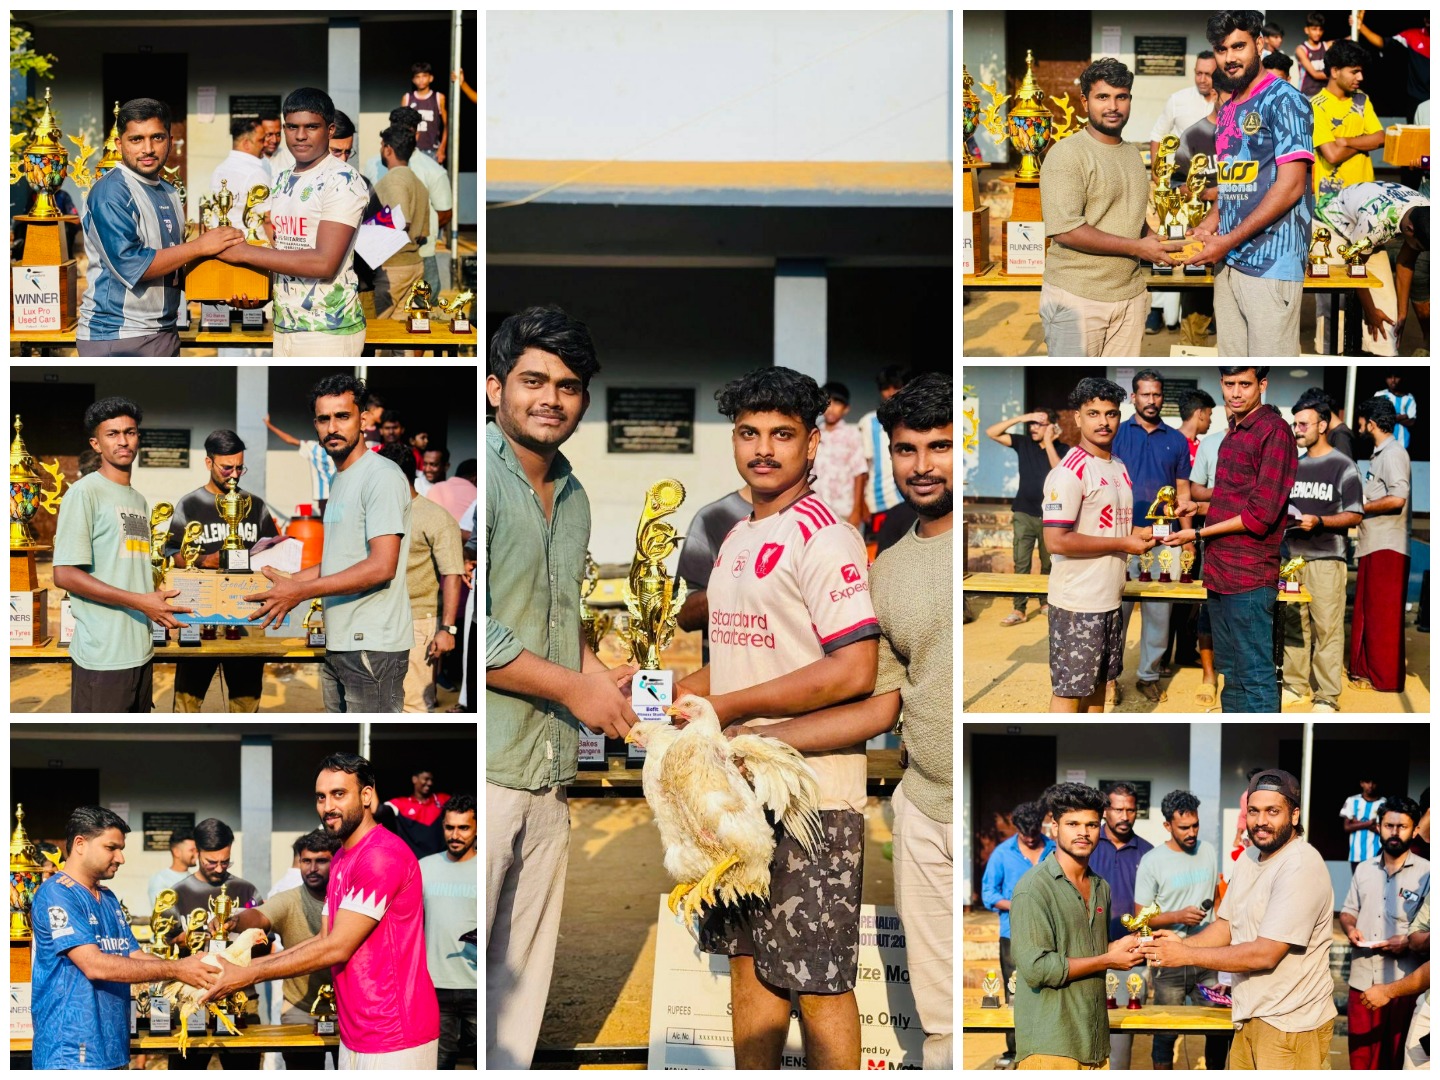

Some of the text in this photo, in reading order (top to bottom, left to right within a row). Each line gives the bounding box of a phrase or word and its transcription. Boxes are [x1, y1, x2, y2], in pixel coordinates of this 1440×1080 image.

[1009, 243, 1043, 251] RUNNERS
[1028, 258, 1043, 266] Tyres
[15, 293, 59, 304] WINNER
[38, 307, 50, 315] Pro
[18, 316, 37, 324] Used
[711, 627, 776, 650] chartered
[860, 915, 900, 931] PENALTY
[667, 1005, 692, 1016] RUPEES
[878, 1012, 911, 1030] Only
[879, 1046, 891, 1057] by
